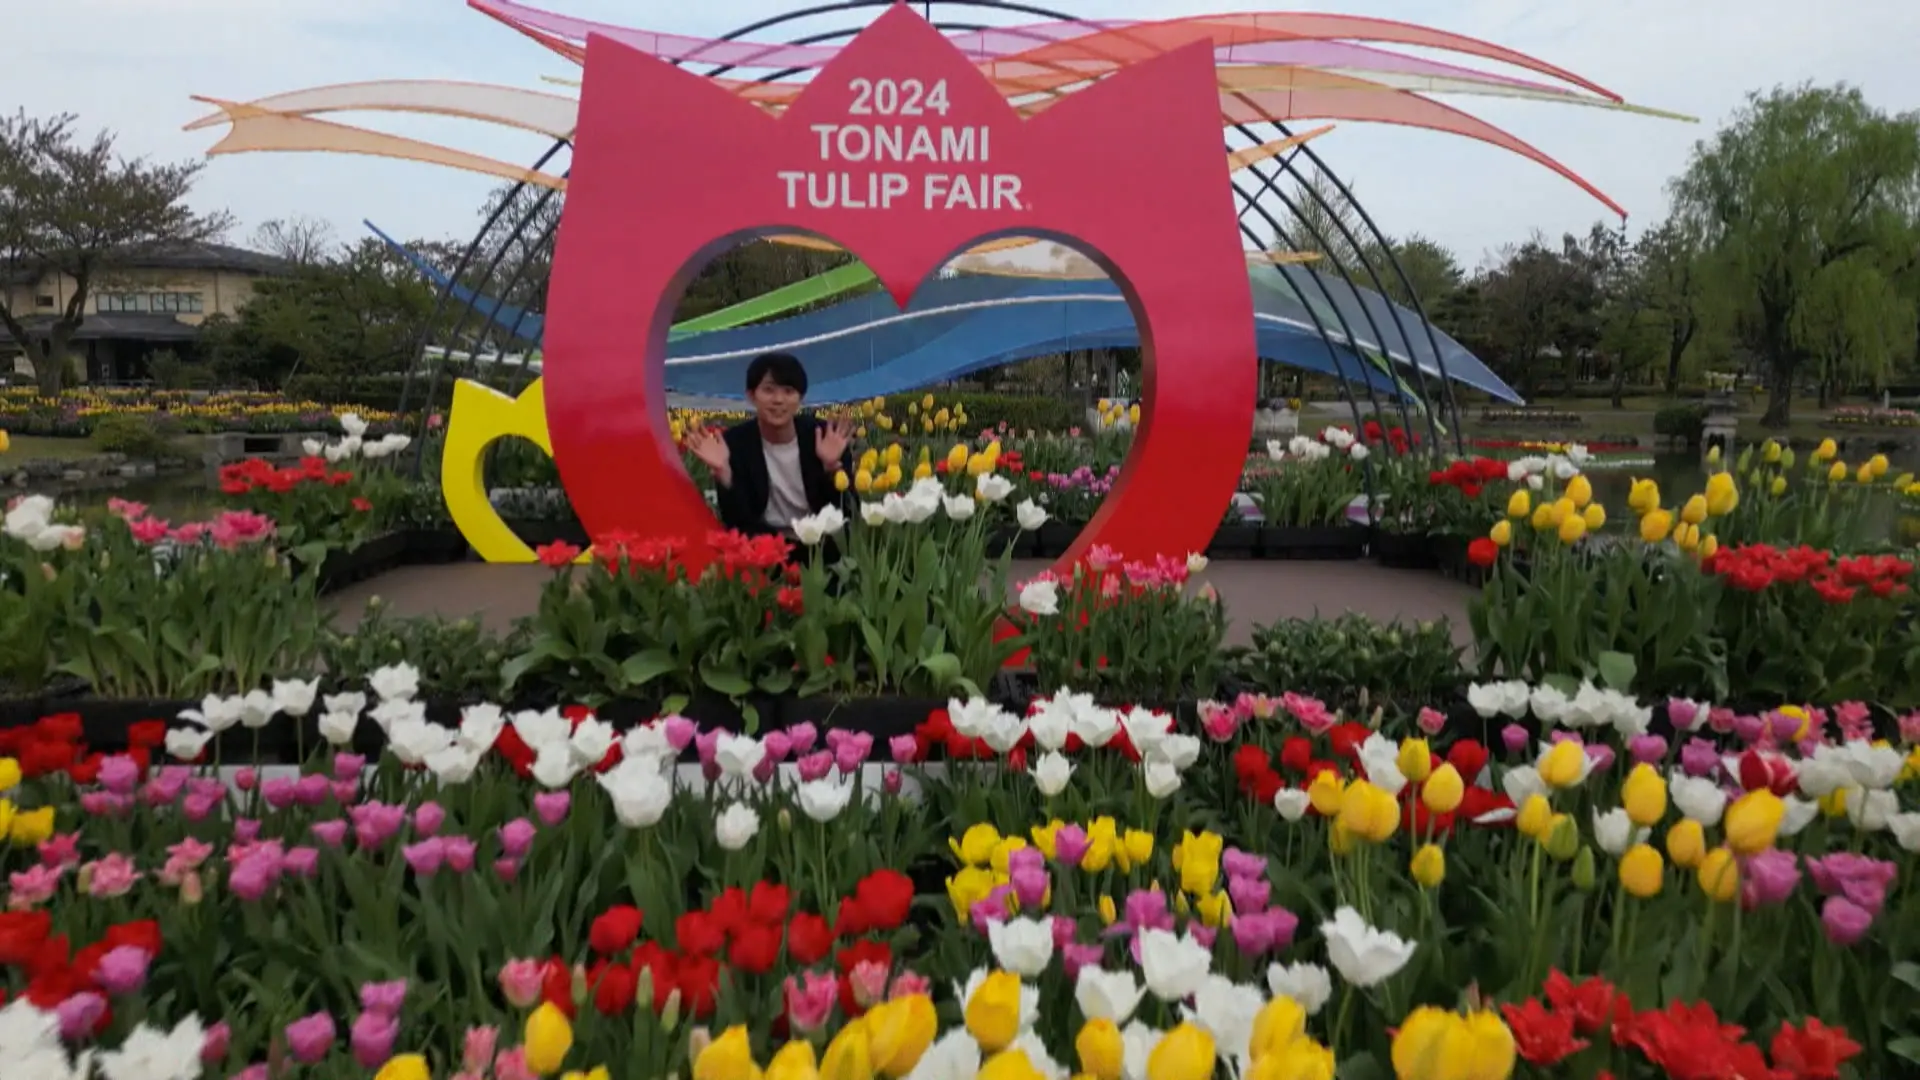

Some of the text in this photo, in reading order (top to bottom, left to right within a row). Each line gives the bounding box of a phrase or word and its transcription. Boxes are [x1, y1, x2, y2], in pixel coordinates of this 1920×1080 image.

[848, 78, 950, 116] 2024
[810, 124, 989, 162] TONAMI
[777, 171, 1023, 210] TULIP FAIR
